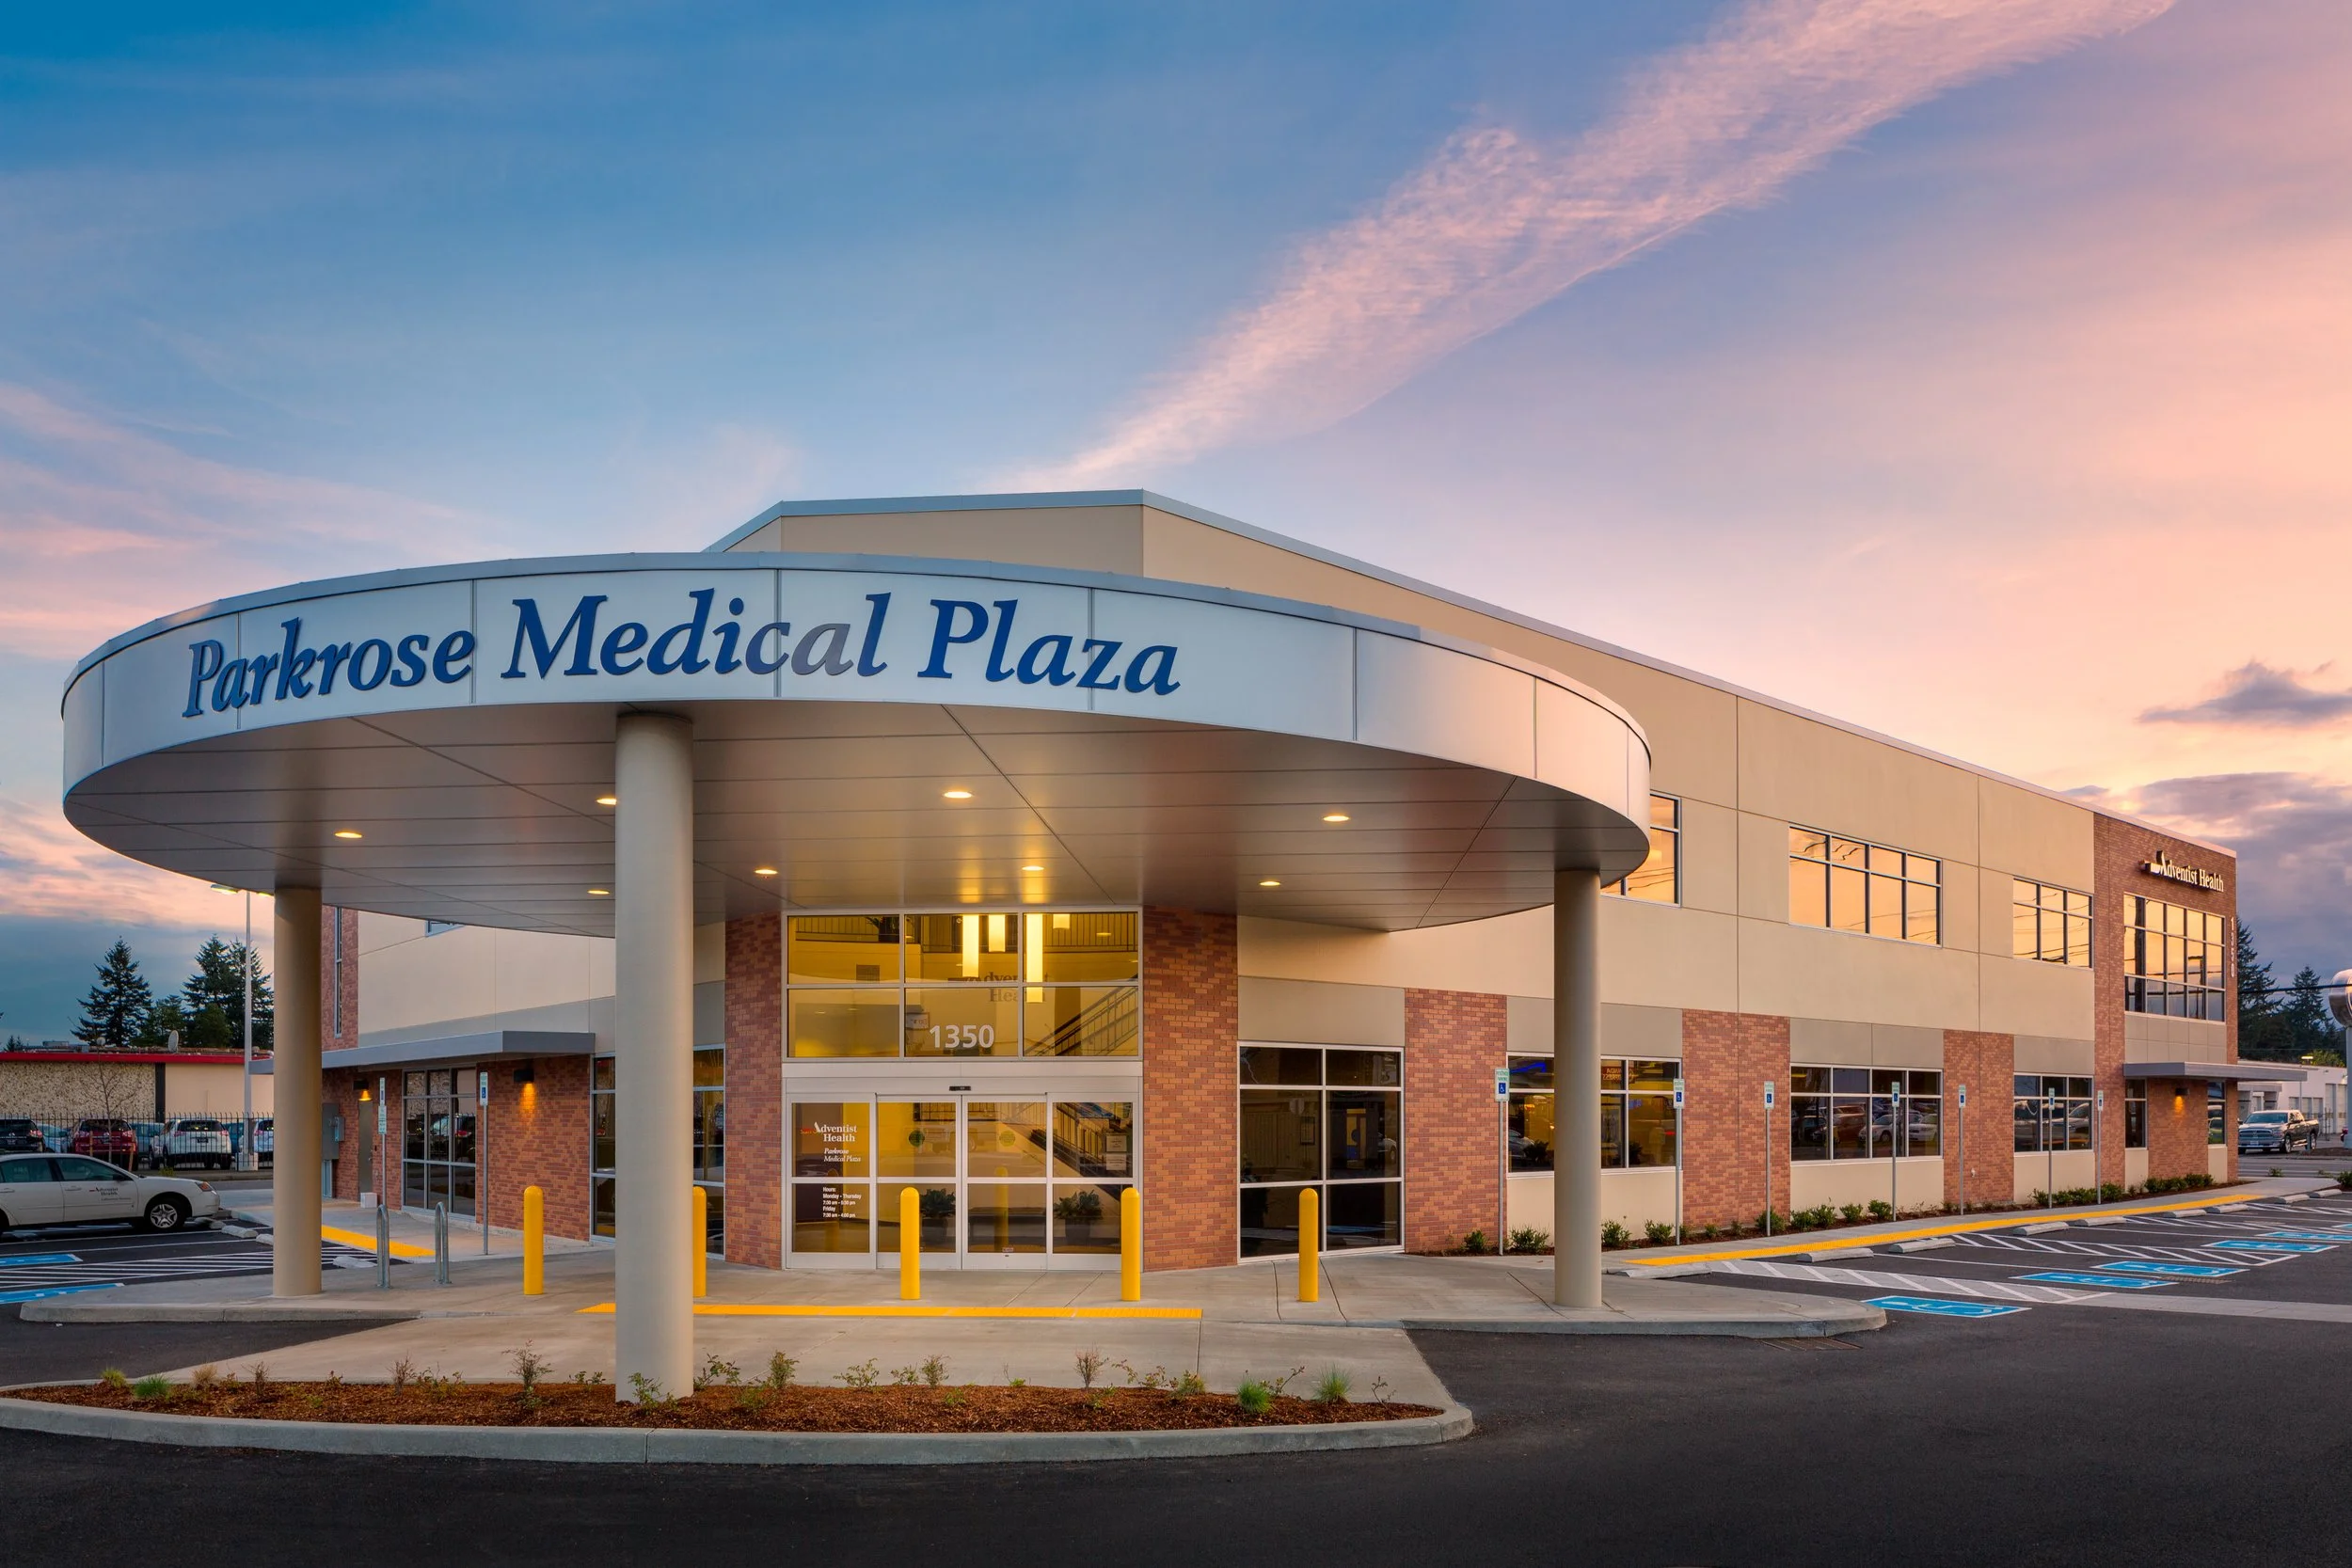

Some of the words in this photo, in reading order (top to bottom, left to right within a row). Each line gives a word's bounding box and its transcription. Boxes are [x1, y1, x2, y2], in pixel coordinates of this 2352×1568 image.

[182, 617, 476, 718] Parkrose
[501, 587, 892, 679] Medical
[917, 598, 1181, 695] Plaza
[2159, 850, 2198, 885] Adventist
[2199, 869, 2224, 893] Health
[930, 1024, 994, 1049] 1350
[814, 1121, 858, 1133] Adventist
[823, 1132, 855, 1142] Health
